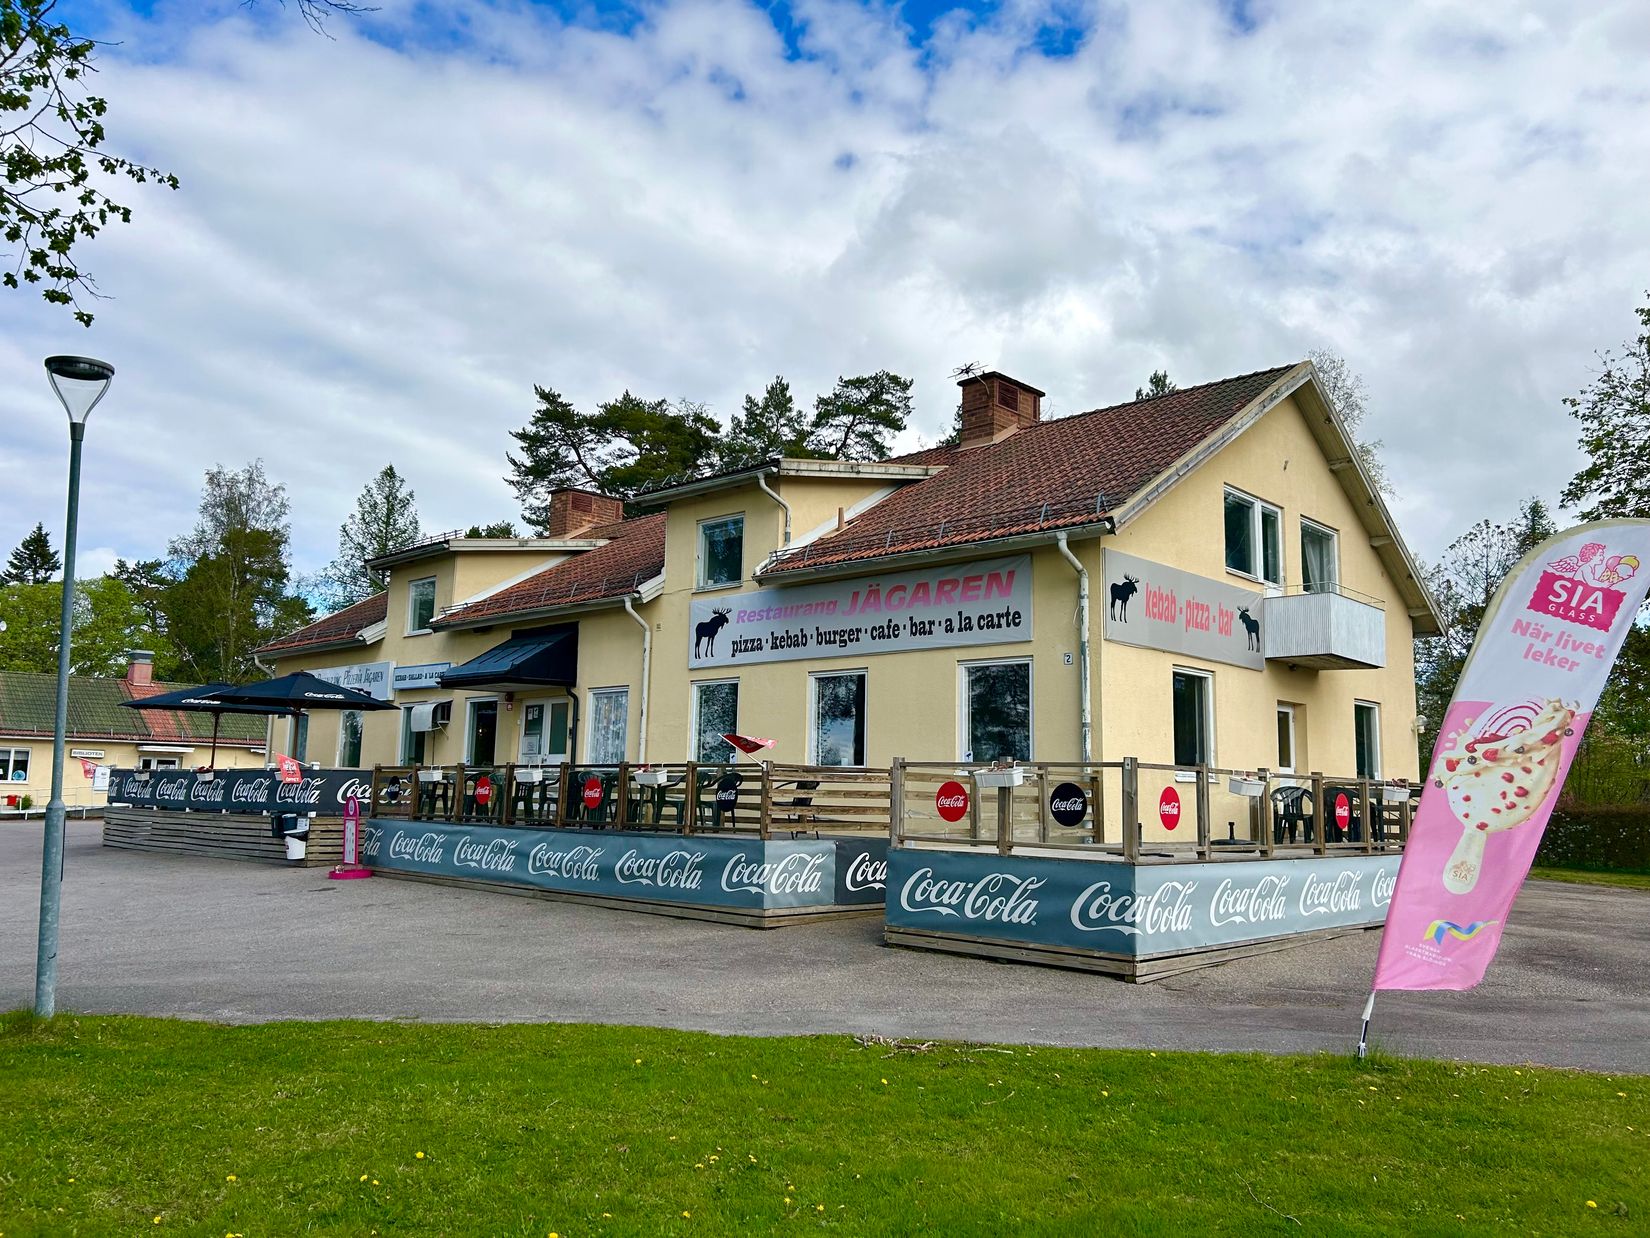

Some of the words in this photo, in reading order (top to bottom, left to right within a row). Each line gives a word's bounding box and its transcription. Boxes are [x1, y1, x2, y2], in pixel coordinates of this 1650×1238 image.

[736, 599, 838, 624] Restaurang
[841, 569, 1016, 616] JÄGAREN
[1145, 582, 1177, 624] kebab
[1185, 595, 1210, 632] pizza
[1218, 602, 1234, 637] bar
[1547, 580, 1603, 614] SIA
[1548, 603, 1596, 622] GLASS
[731, 635, 763, 657] pizza
[770, 628, 808, 650] kebab
[815, 626, 862, 648] burger
[870, 618, 900, 640] cafe
[909, 616, 935, 637] bar
[944, 617, 955, 634] a
[957, 610, 974, 633] la
[977, 605, 1022, 630] carte
[1511, 617, 1554, 643] När
[1554, 630, 1606, 659] livet
[1066, 654, 1071, 663] 2
[1523, 642, 1581, 672] leker
[938, 795, 966, 807] Coca-Cola
[1052, 797, 1084, 811] Coca-Cola
[390, 830, 448, 863] Coca-Cola
[453, 835, 520, 872] Coca-Cola
[528, 842, 606, 881] Coca-Cola
[614, 849, 708, 889] Coca-Cola
[721, 852, 830, 895] Coca-Cola
[1452, 870, 1468, 881] SIA
[900, 867, 1048, 926] Coca-Cola
[1070, 880, 1199, 936] Coca-Cola
[1210, 875, 1291, 927] Coca-Cola
[1299, 870, 1363, 916] Coca-Cola
